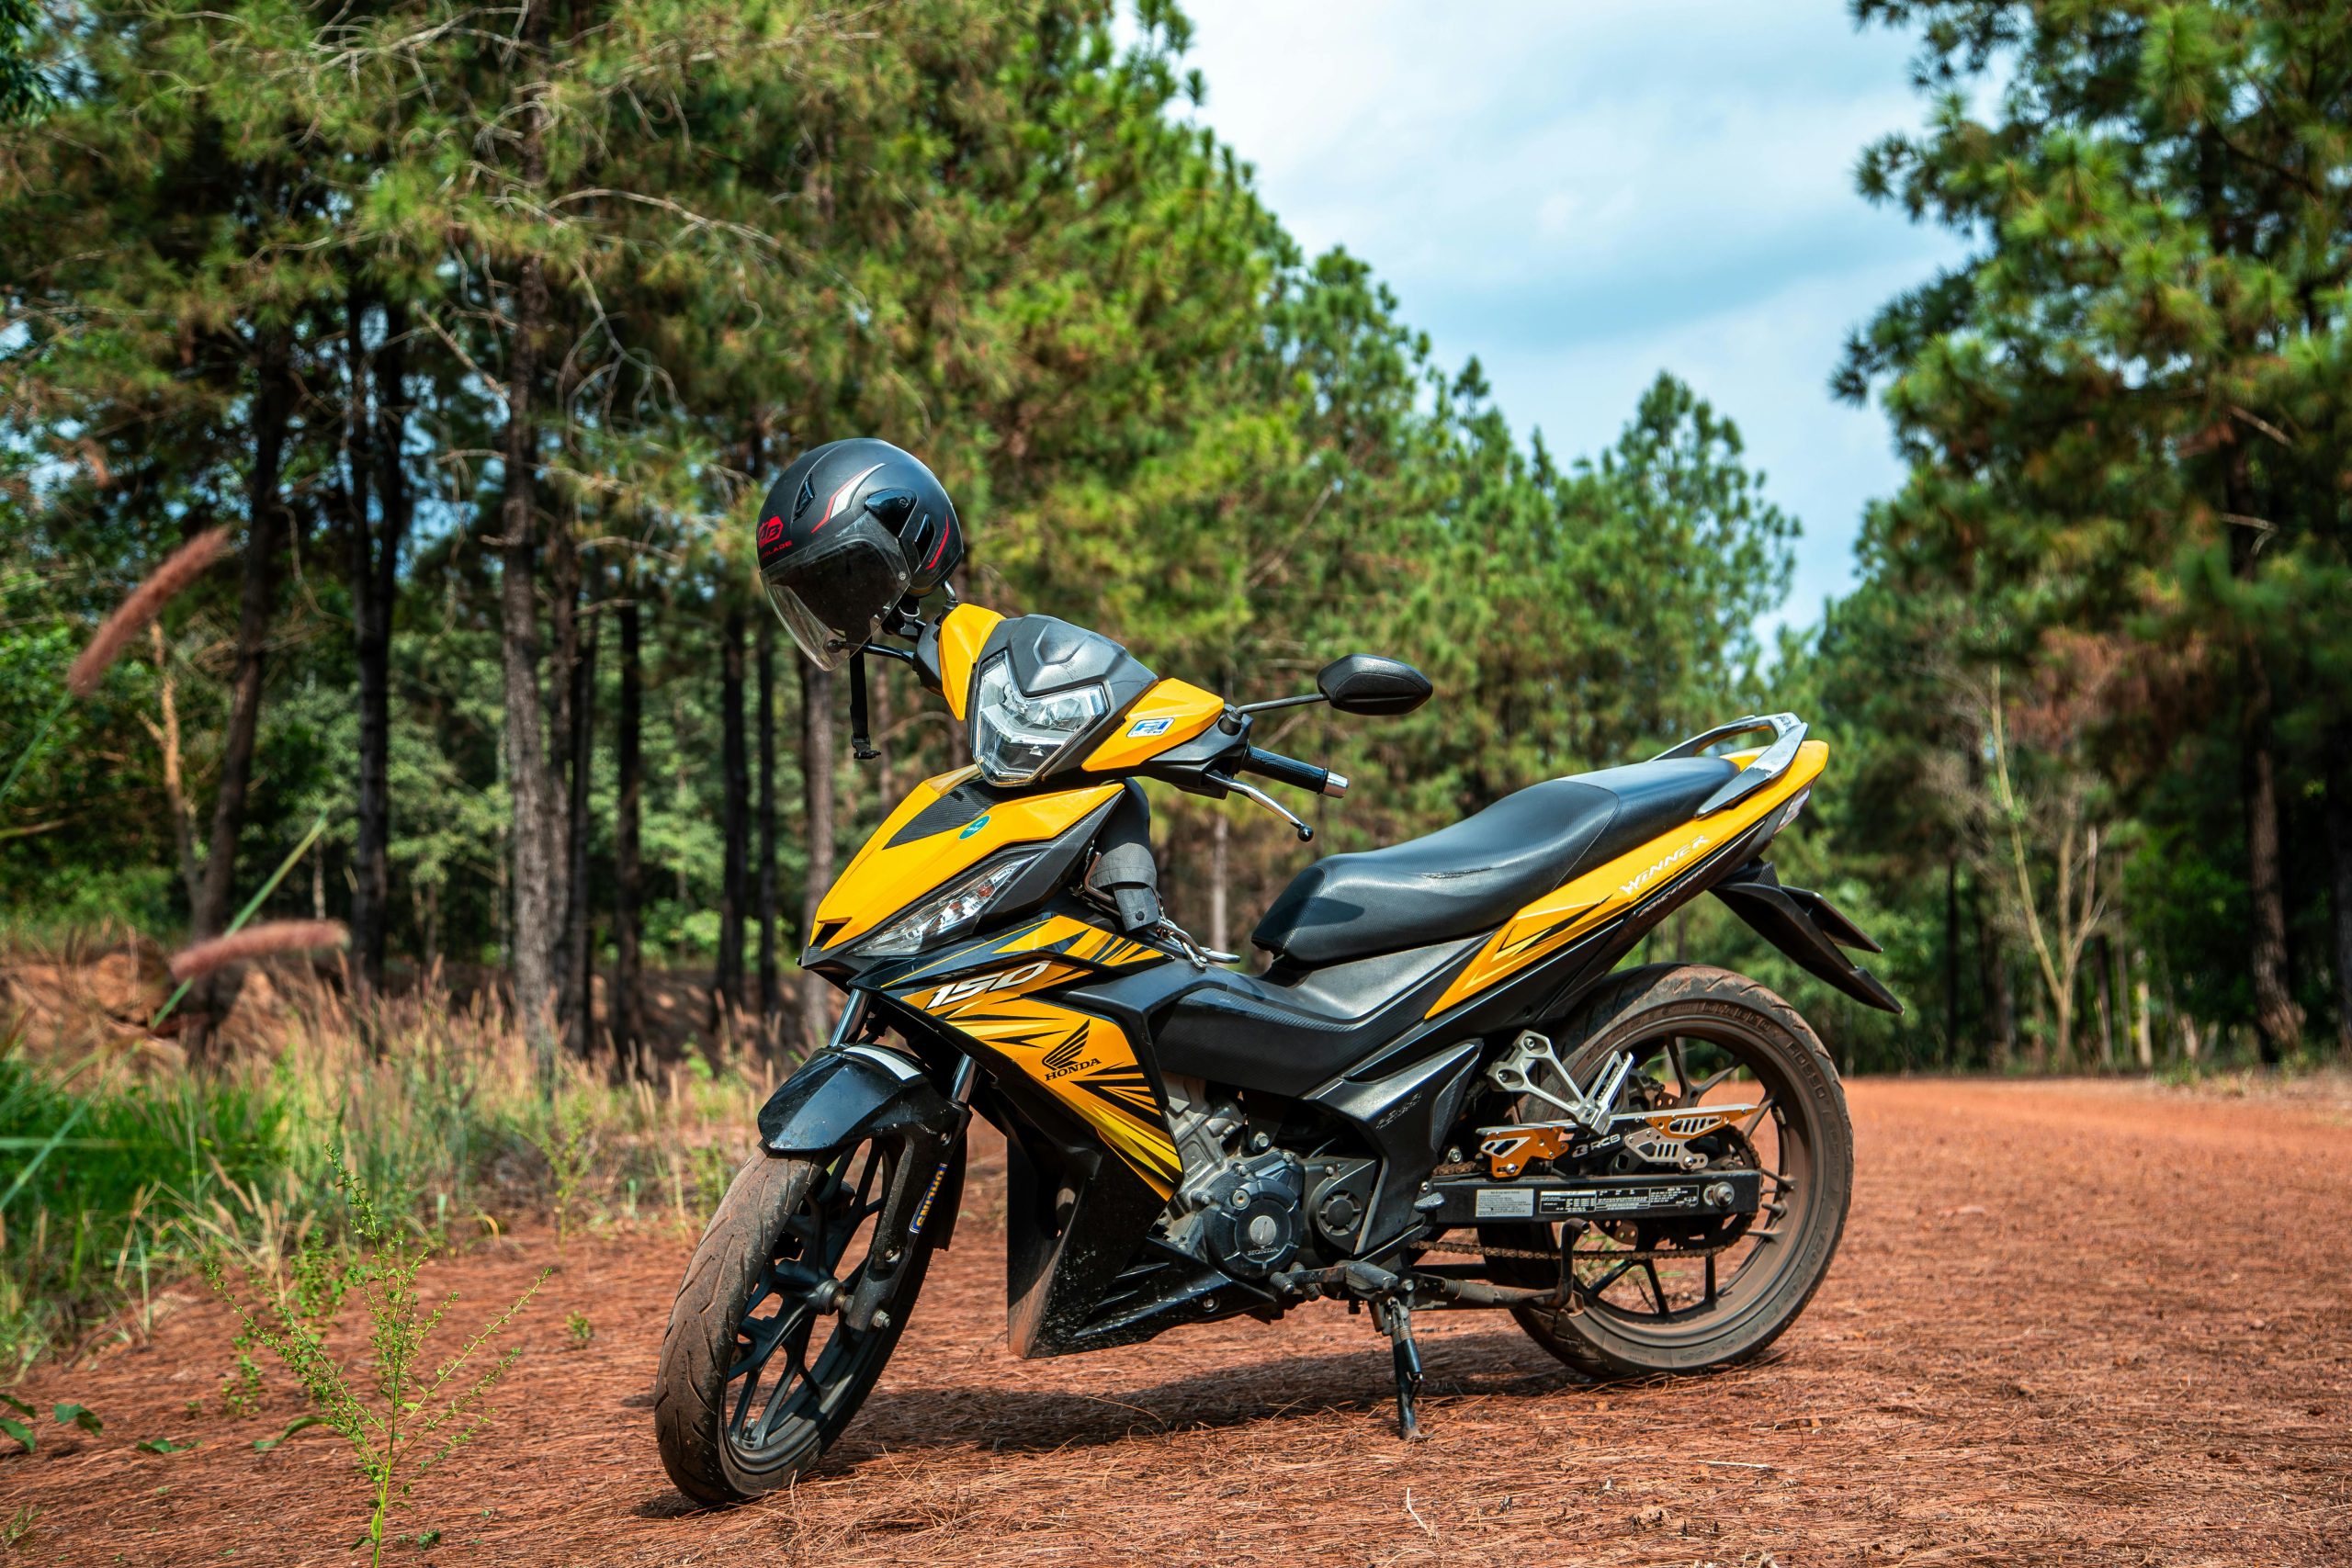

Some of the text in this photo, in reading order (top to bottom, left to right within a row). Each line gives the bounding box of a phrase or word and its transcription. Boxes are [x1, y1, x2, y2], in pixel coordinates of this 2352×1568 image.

[1619, 835, 1710, 895] WINNER
[926, 960, 1053, 1010] 150
[1045, 1057, 1102, 1082] HONDA
[1590, 1134, 1621, 1151] RCB
